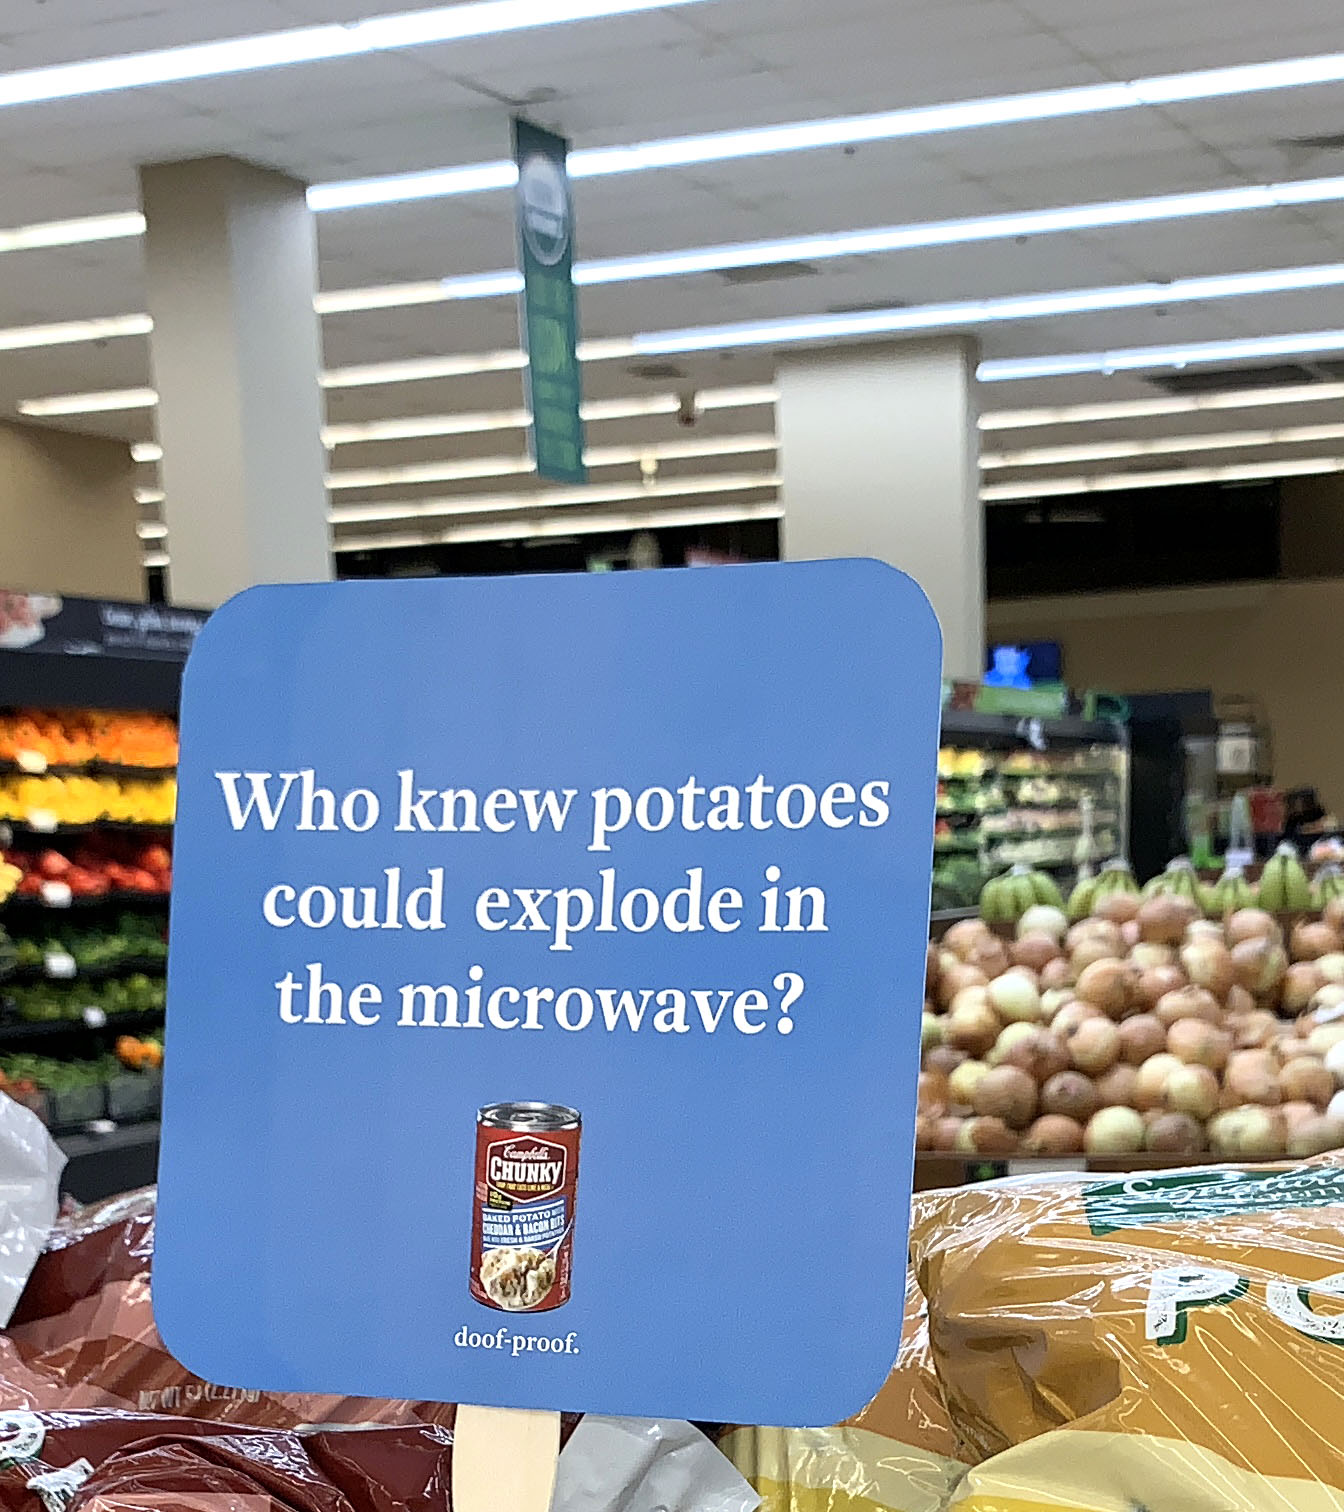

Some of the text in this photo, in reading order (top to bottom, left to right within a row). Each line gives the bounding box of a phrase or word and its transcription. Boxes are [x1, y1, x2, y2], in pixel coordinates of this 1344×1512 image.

[215, 769, 891, 852] Who knew potatoes
[262, 866, 830, 952] could explode in
[275, 963, 805, 1036] the microwave?
[490, 1155, 563, 1185] CHUNKY
[512, 1211, 551, 1224] POTATO
[454, 1325, 580, 1357] doof-proof.
